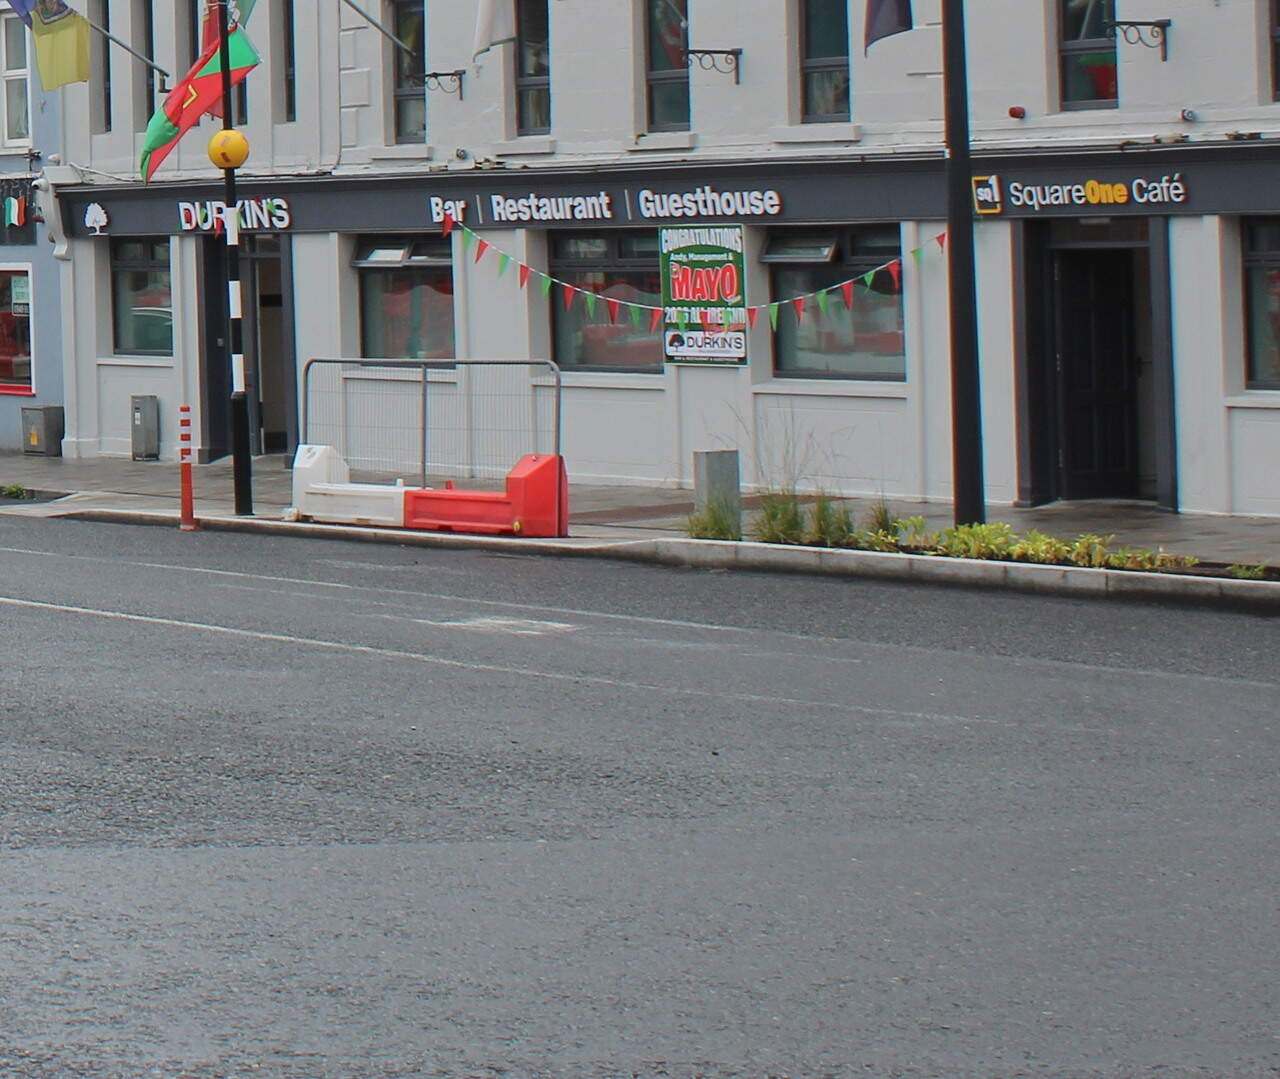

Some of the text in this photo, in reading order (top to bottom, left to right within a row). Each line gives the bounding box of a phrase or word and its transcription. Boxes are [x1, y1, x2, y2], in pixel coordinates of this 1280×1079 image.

[430, 186, 780, 222] Bar Restaurant Guesthouse
[1009, 172, 1185, 211] SquareOne Café
[670, 263, 738, 301] MAYO
[686, 336, 743, 350] DURKIN'S
